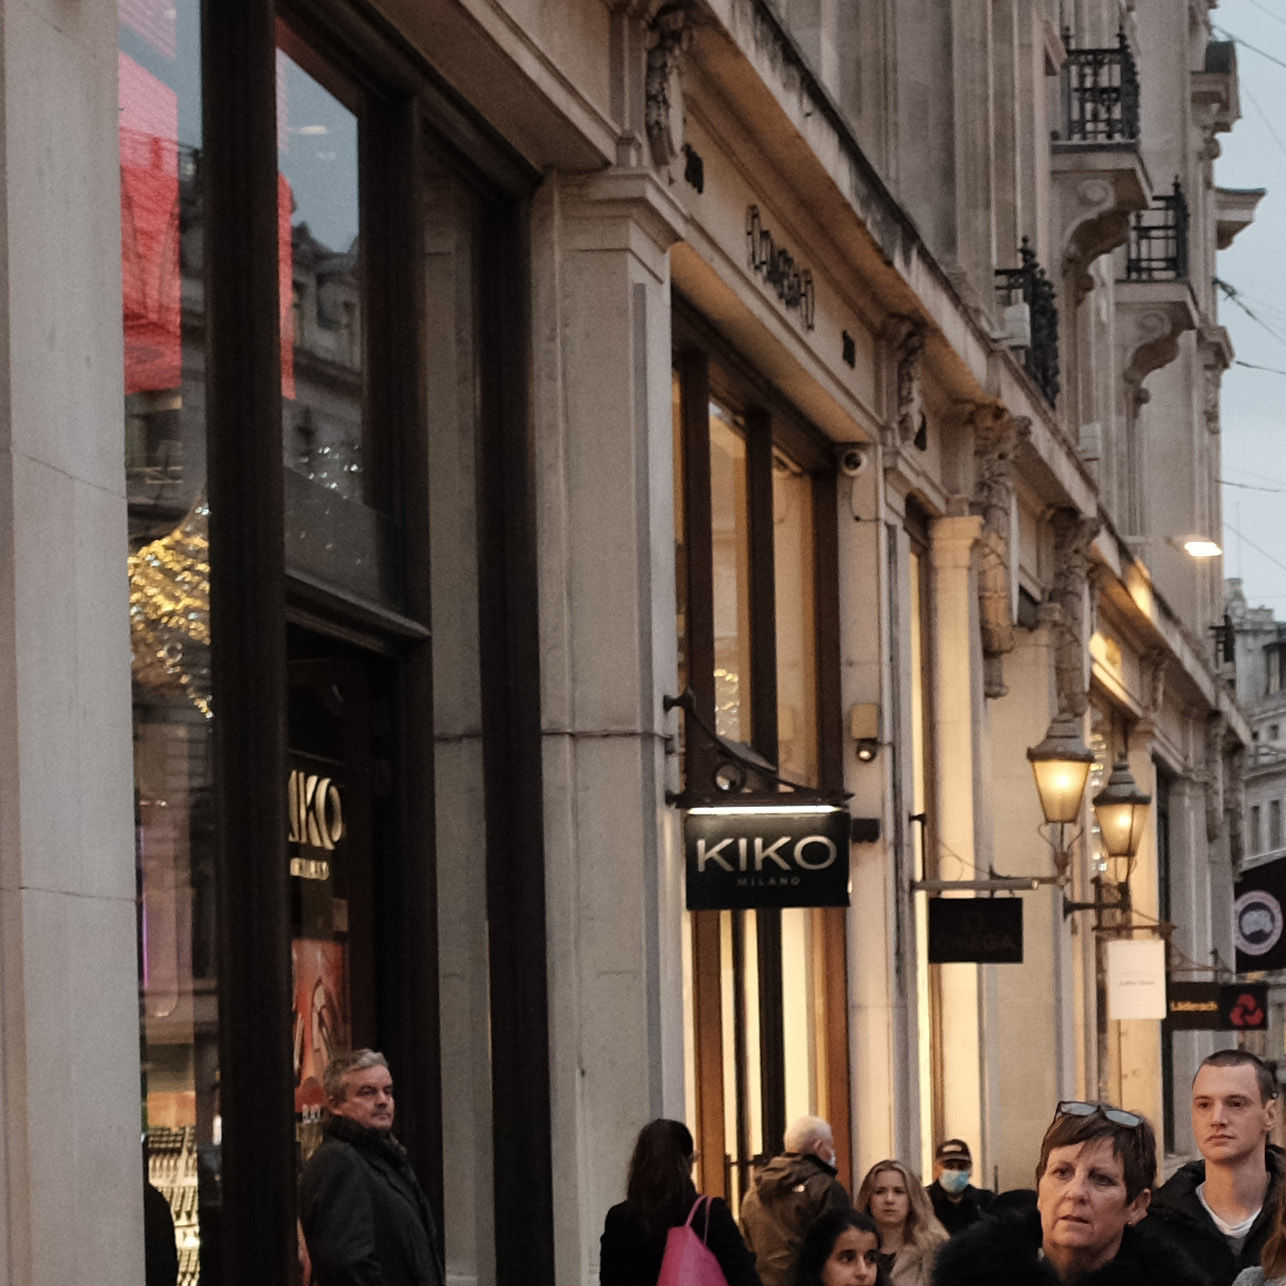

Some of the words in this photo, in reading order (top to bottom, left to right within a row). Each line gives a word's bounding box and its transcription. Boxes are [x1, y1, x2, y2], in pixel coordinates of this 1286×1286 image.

[288, 769, 344, 850] IKO
[697, 835, 837, 872] KIKO
[737, 877, 801, 886] MILANO
